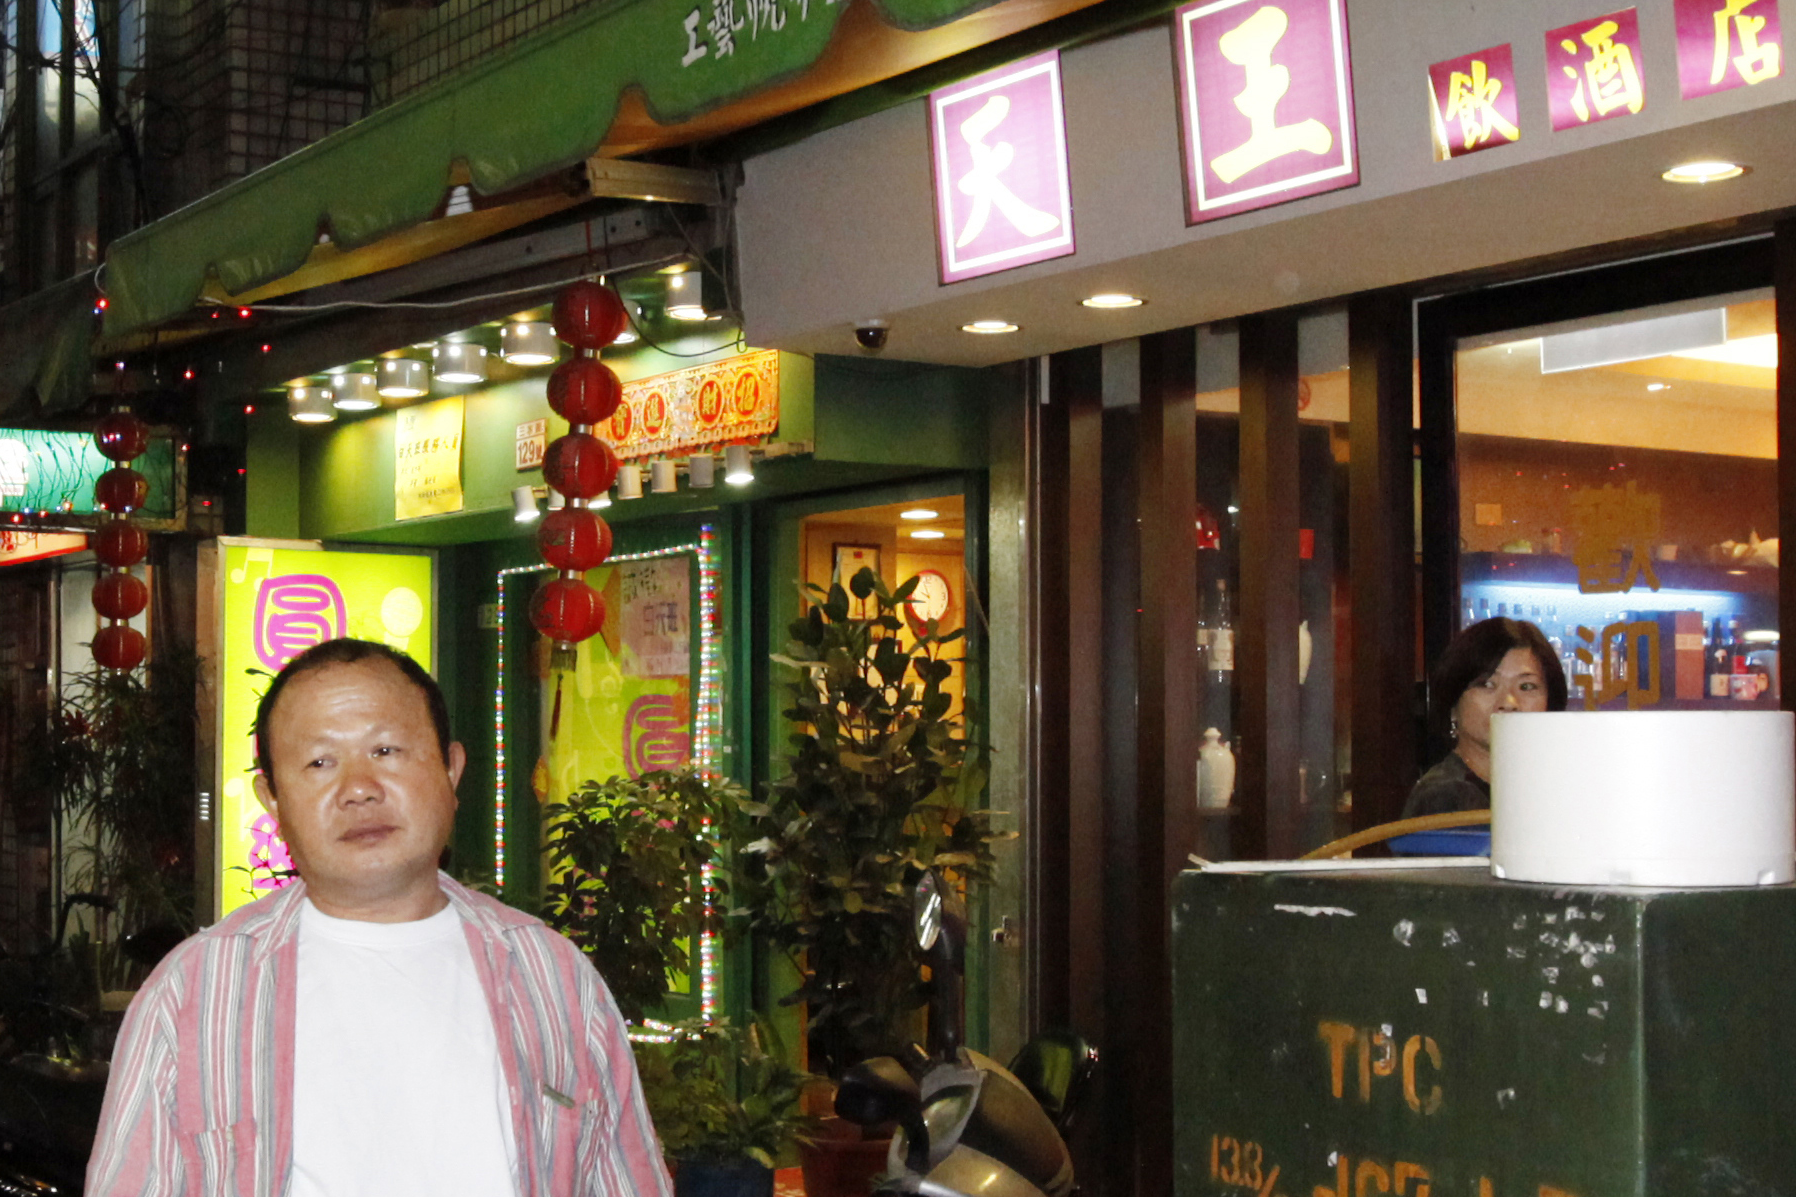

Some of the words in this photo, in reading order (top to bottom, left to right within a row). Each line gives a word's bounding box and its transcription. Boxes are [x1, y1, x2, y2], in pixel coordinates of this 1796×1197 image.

[954, 4, 1334, 250] 天王
[1442, 0, 1786, 152] 飲酒店
[1570, 480, 1662, 711] 歡迎
[1316, 1019, 1444, 1117] TPC
